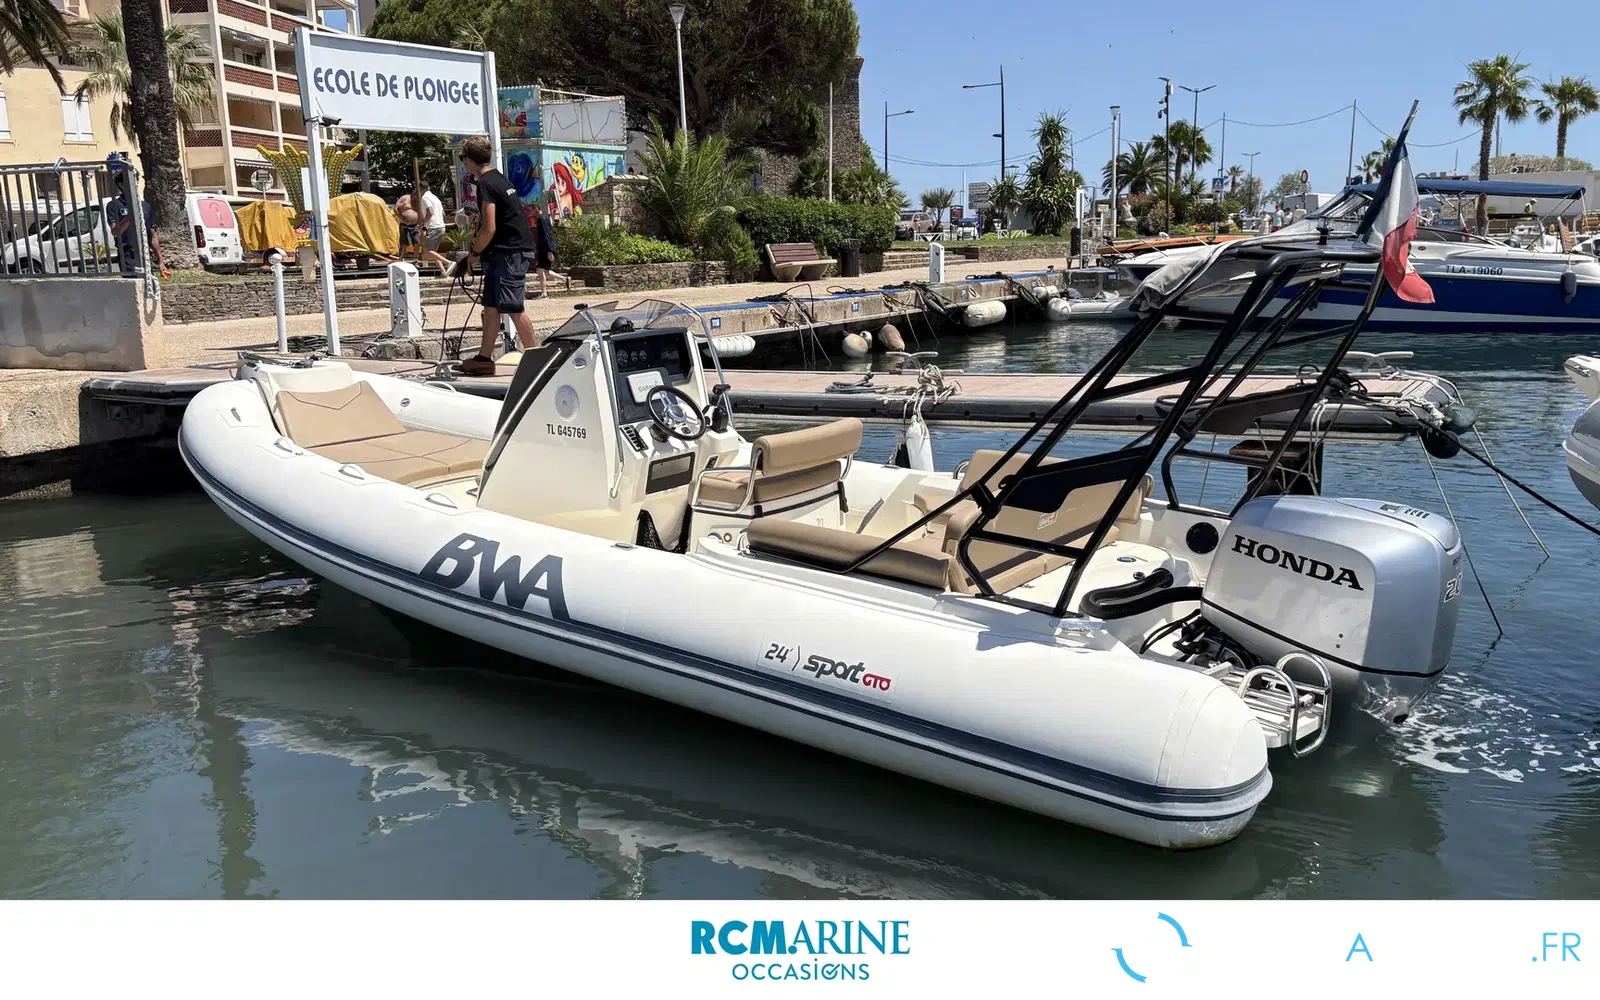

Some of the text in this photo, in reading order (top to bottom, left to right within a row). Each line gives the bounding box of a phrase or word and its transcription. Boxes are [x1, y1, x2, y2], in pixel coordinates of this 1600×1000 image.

[313, 67, 480, 105] ECOLE DE PLONGEE
[1445, 265, 1503, 276] TLA-19060
[546, 423, 556, 435] TL
[419, 532, 571, 620] BWA
[1231, 534, 1364, 591] HONDA
